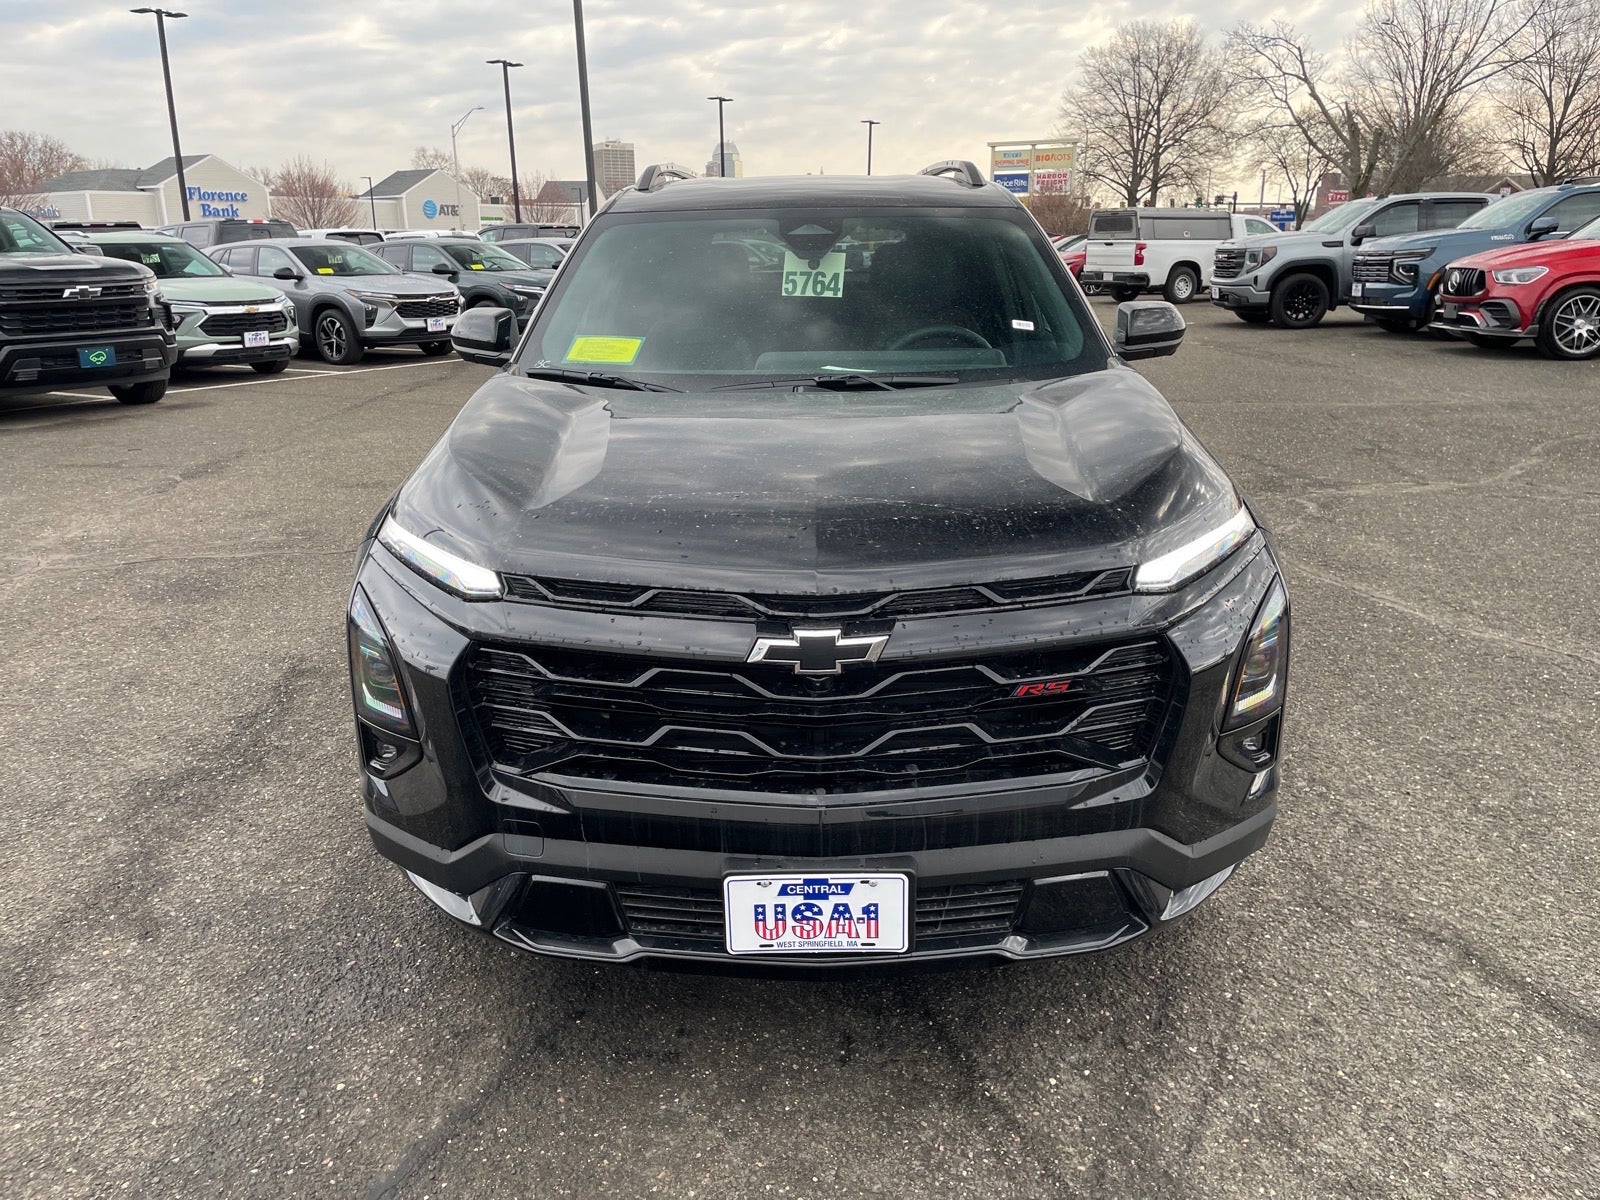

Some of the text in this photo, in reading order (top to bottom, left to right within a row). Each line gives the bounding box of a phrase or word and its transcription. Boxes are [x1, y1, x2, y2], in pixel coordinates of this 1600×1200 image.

[187, 186, 248, 202] Florence
[200, 203, 240, 218] Bank
[784, 271, 841, 297] 5764
[1014, 680, 1071, 697] RS
[787, 885, 845, 895] CENTRAL
